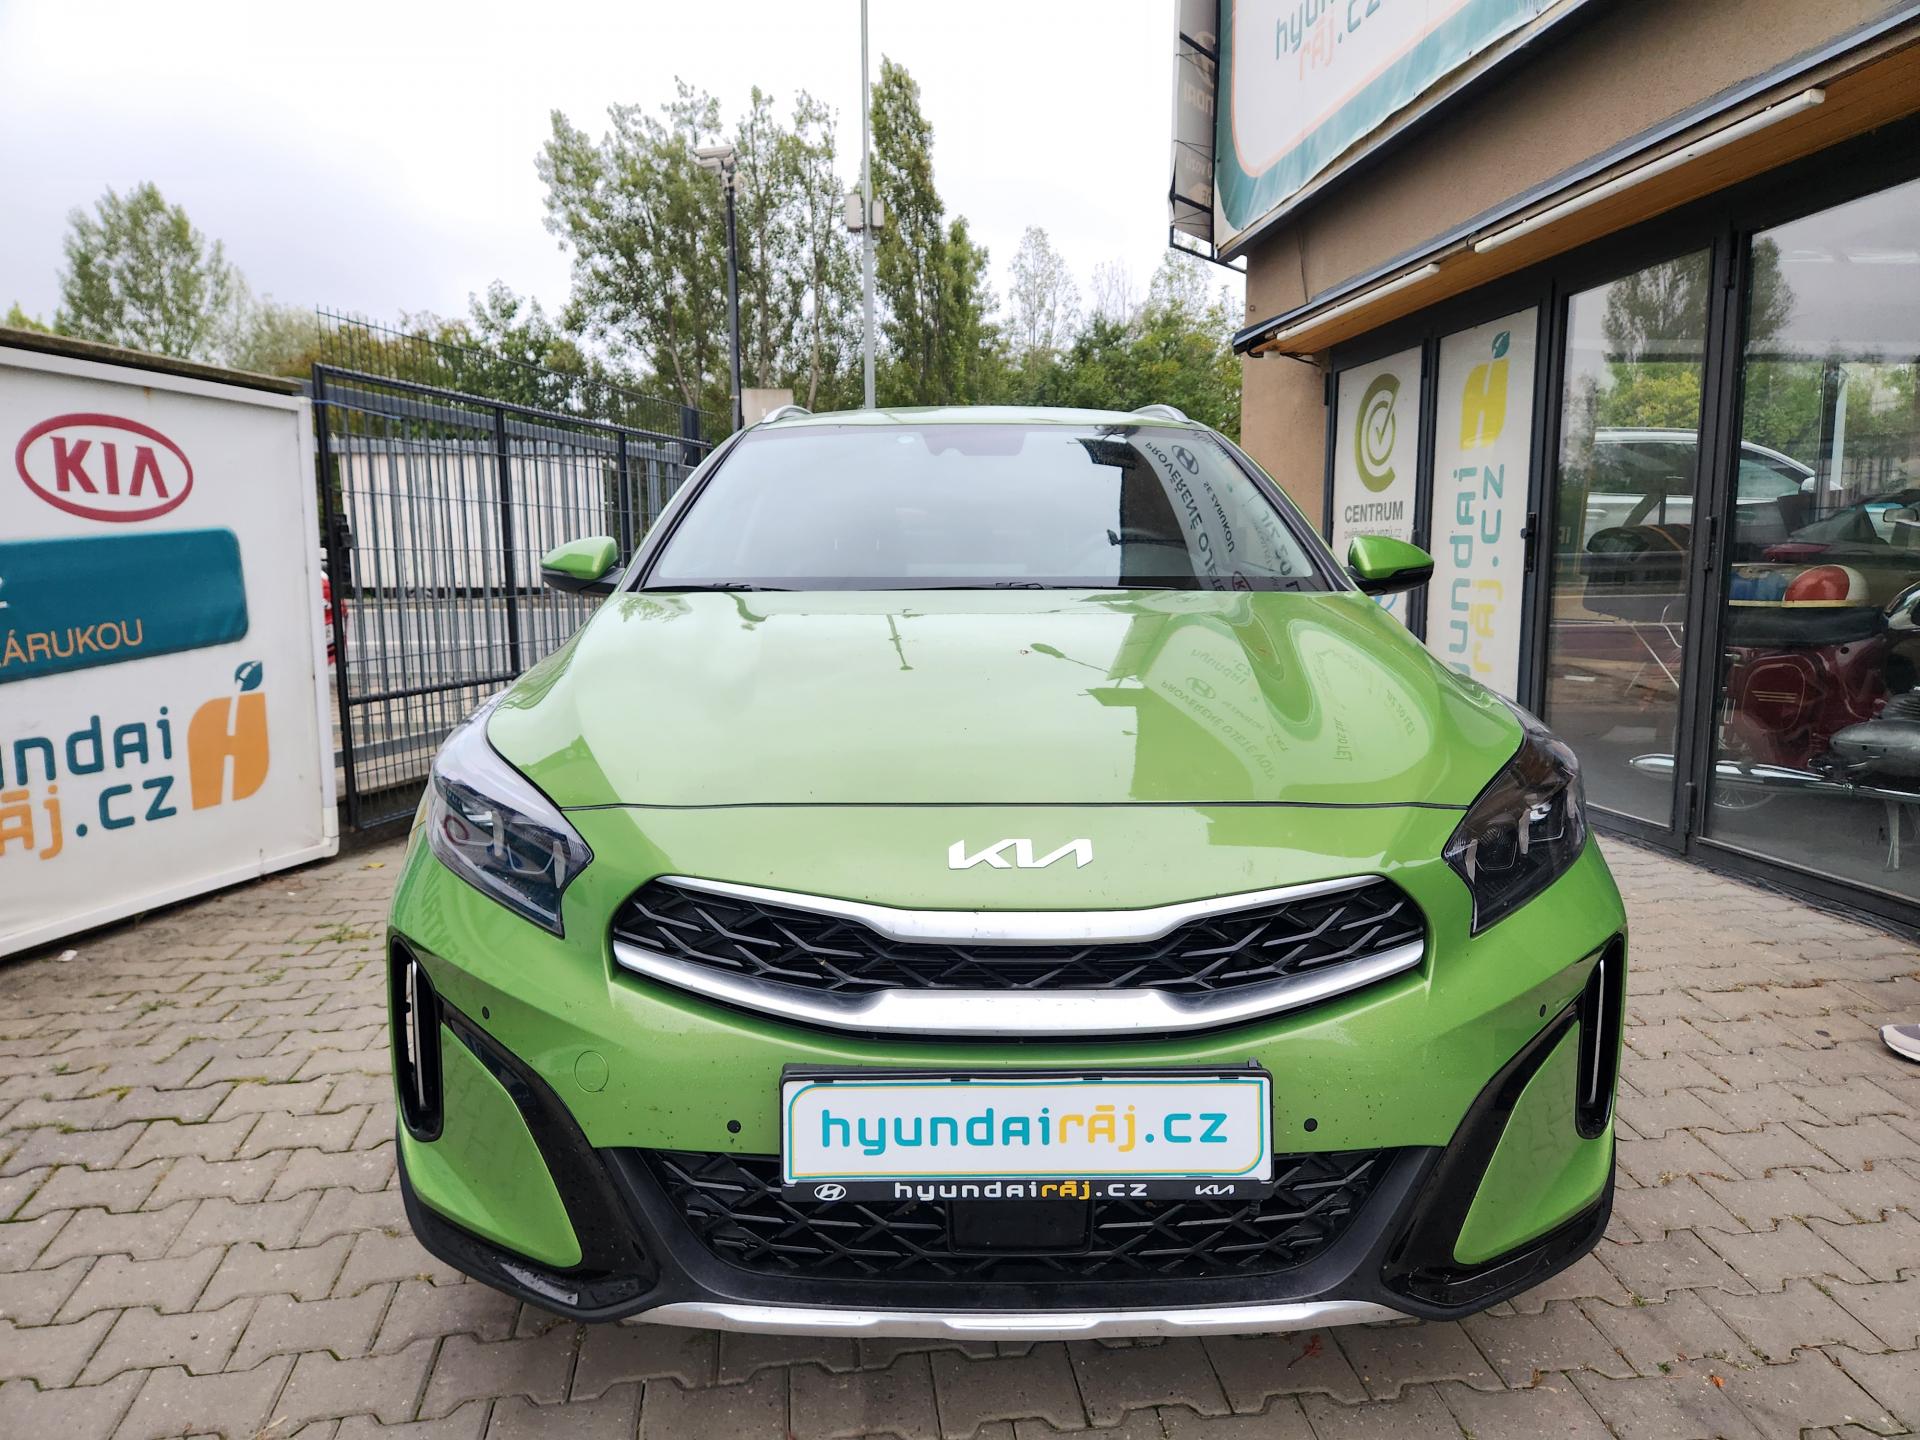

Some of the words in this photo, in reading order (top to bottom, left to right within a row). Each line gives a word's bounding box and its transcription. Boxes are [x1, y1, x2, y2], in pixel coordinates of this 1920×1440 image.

[50, 436, 169, 498] KIA
[1344, 501, 1404, 523] CENTRUM
[0, 618, 143, 667] ÁRUKOU
[0, 706, 172, 791] ndai
[948, 838, 1093, 870] KIA
